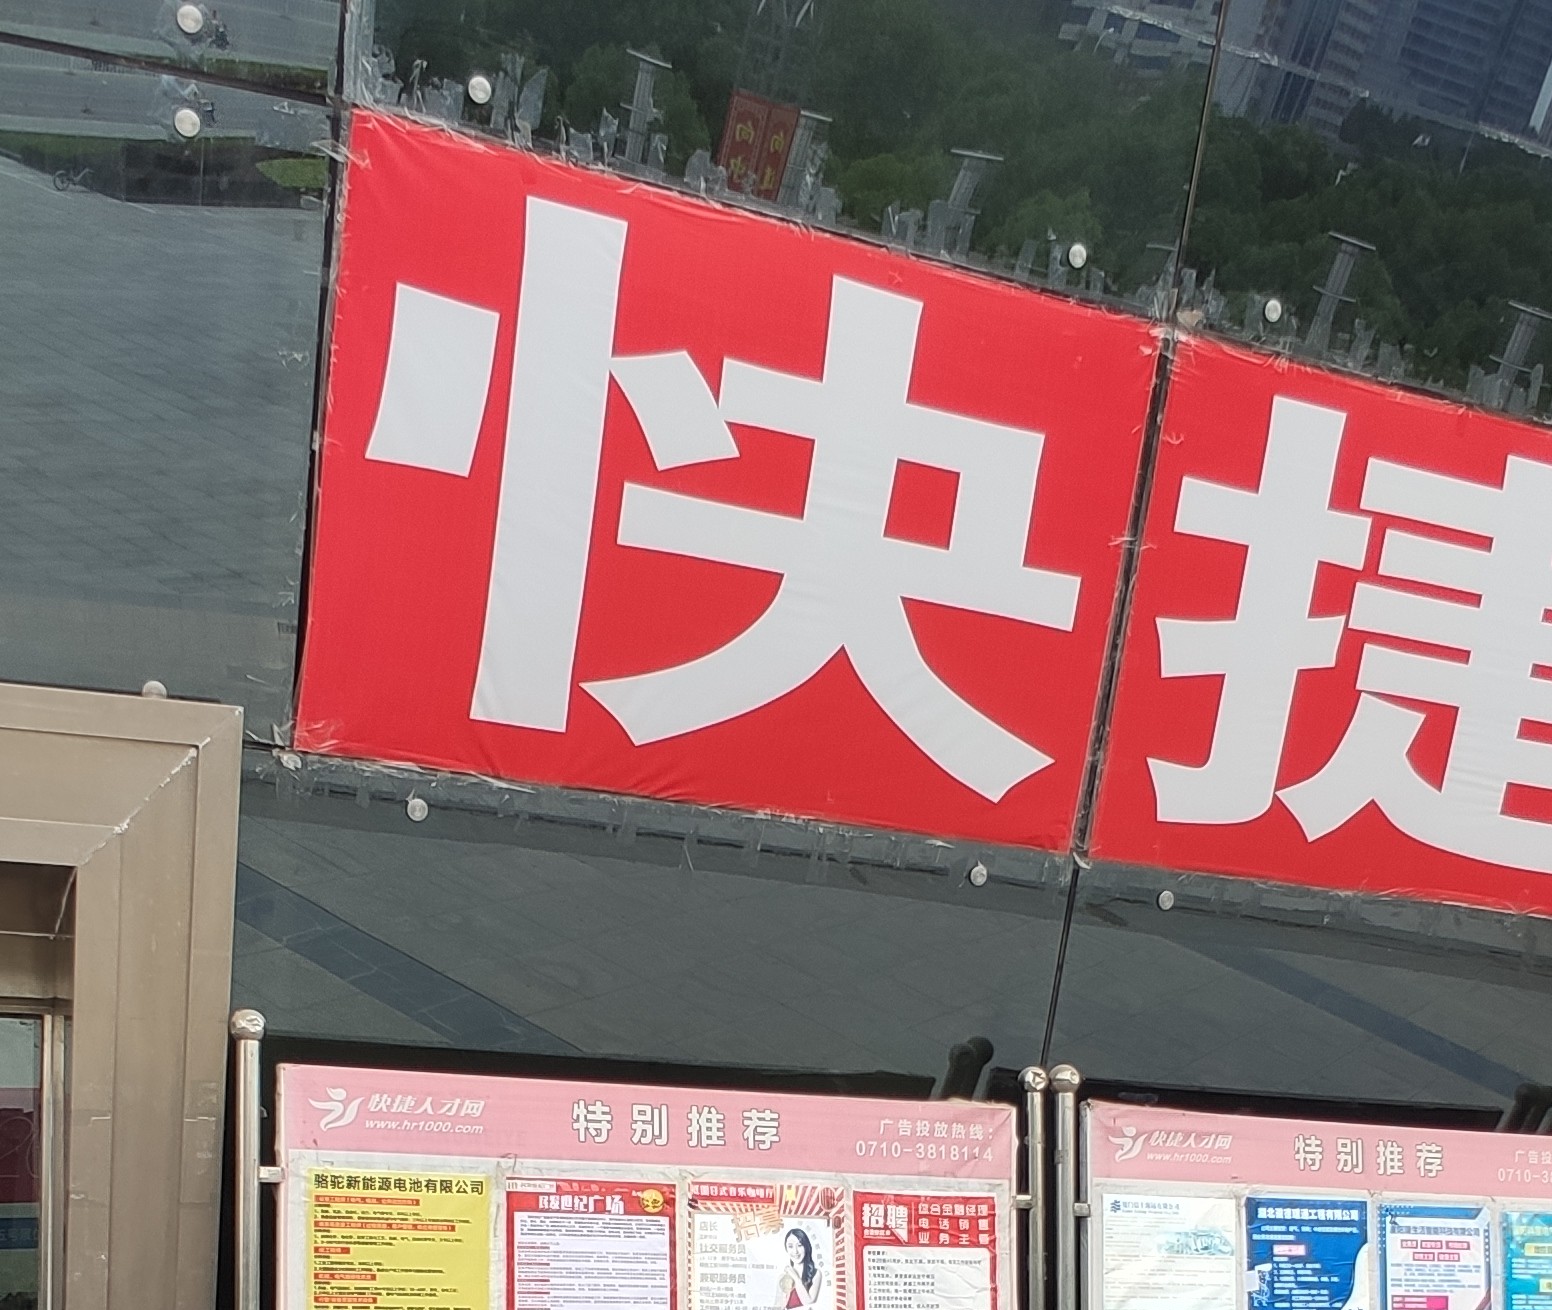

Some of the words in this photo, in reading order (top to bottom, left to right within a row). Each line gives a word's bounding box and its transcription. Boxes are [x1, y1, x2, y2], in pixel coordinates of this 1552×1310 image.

[367, 1093, 485, 1118] 快捷人才网
[364, 1118, 484, 1135] www.hr1000.com
[570, 1099, 782, 1152] 特别推荐
[879, 1118, 995, 1141] 广告投放热线:
[855, 1140, 994, 1163] 0710-3818114
[1149, 1129, 1233, 1151] 快捷人才网
[1146, 1151, 1233, 1165] www.hr1000.com
[1293, 1133, 1444, 1178] 特别推荐
[313, 1173, 484, 1196] 骆驼新能源电池有限公司
[862, 1202, 909, 1230] 招聘
